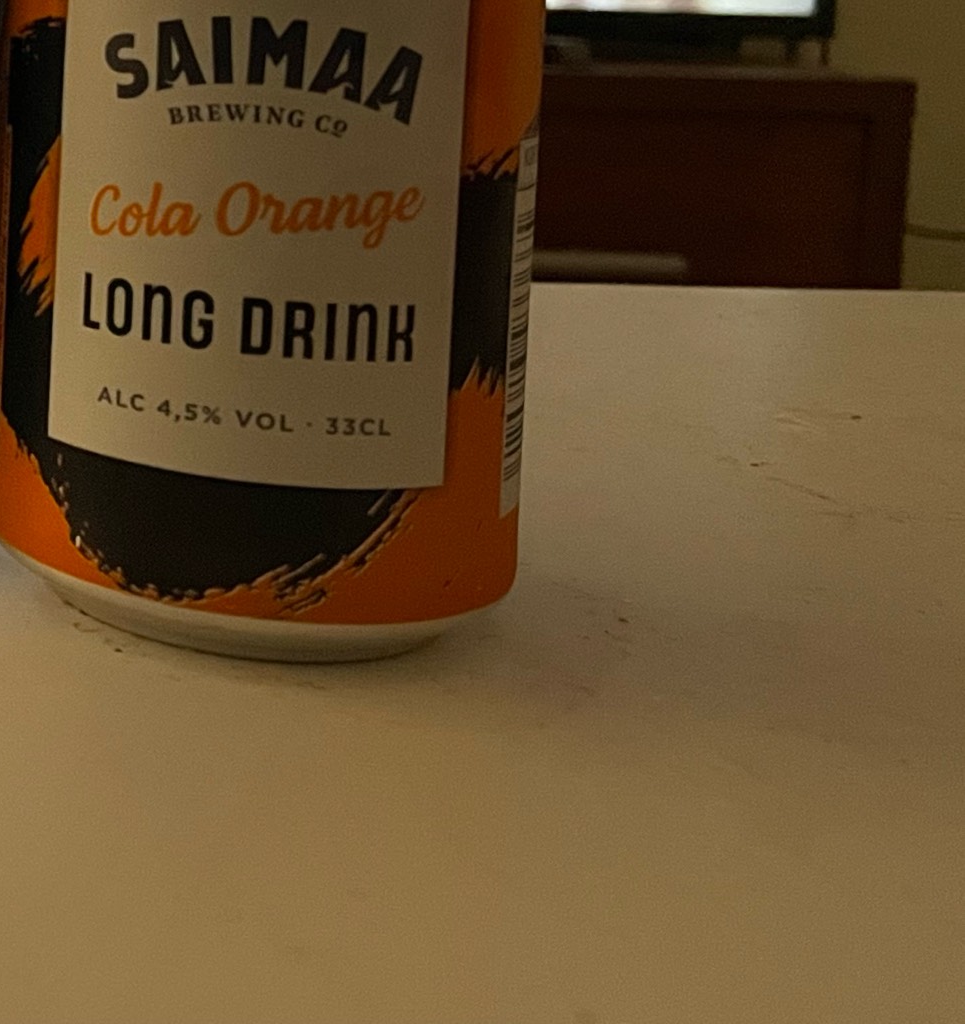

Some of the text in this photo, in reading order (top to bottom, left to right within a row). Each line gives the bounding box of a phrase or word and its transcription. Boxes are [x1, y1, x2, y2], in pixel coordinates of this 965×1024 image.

[104, 15, 424, 126] SAIMAA
[167, 102, 306, 127] BREWING
[89, 180, 426, 249] Cola Orange
[97, 385, 393, 438] ALC 4,5% VOL 33CL
